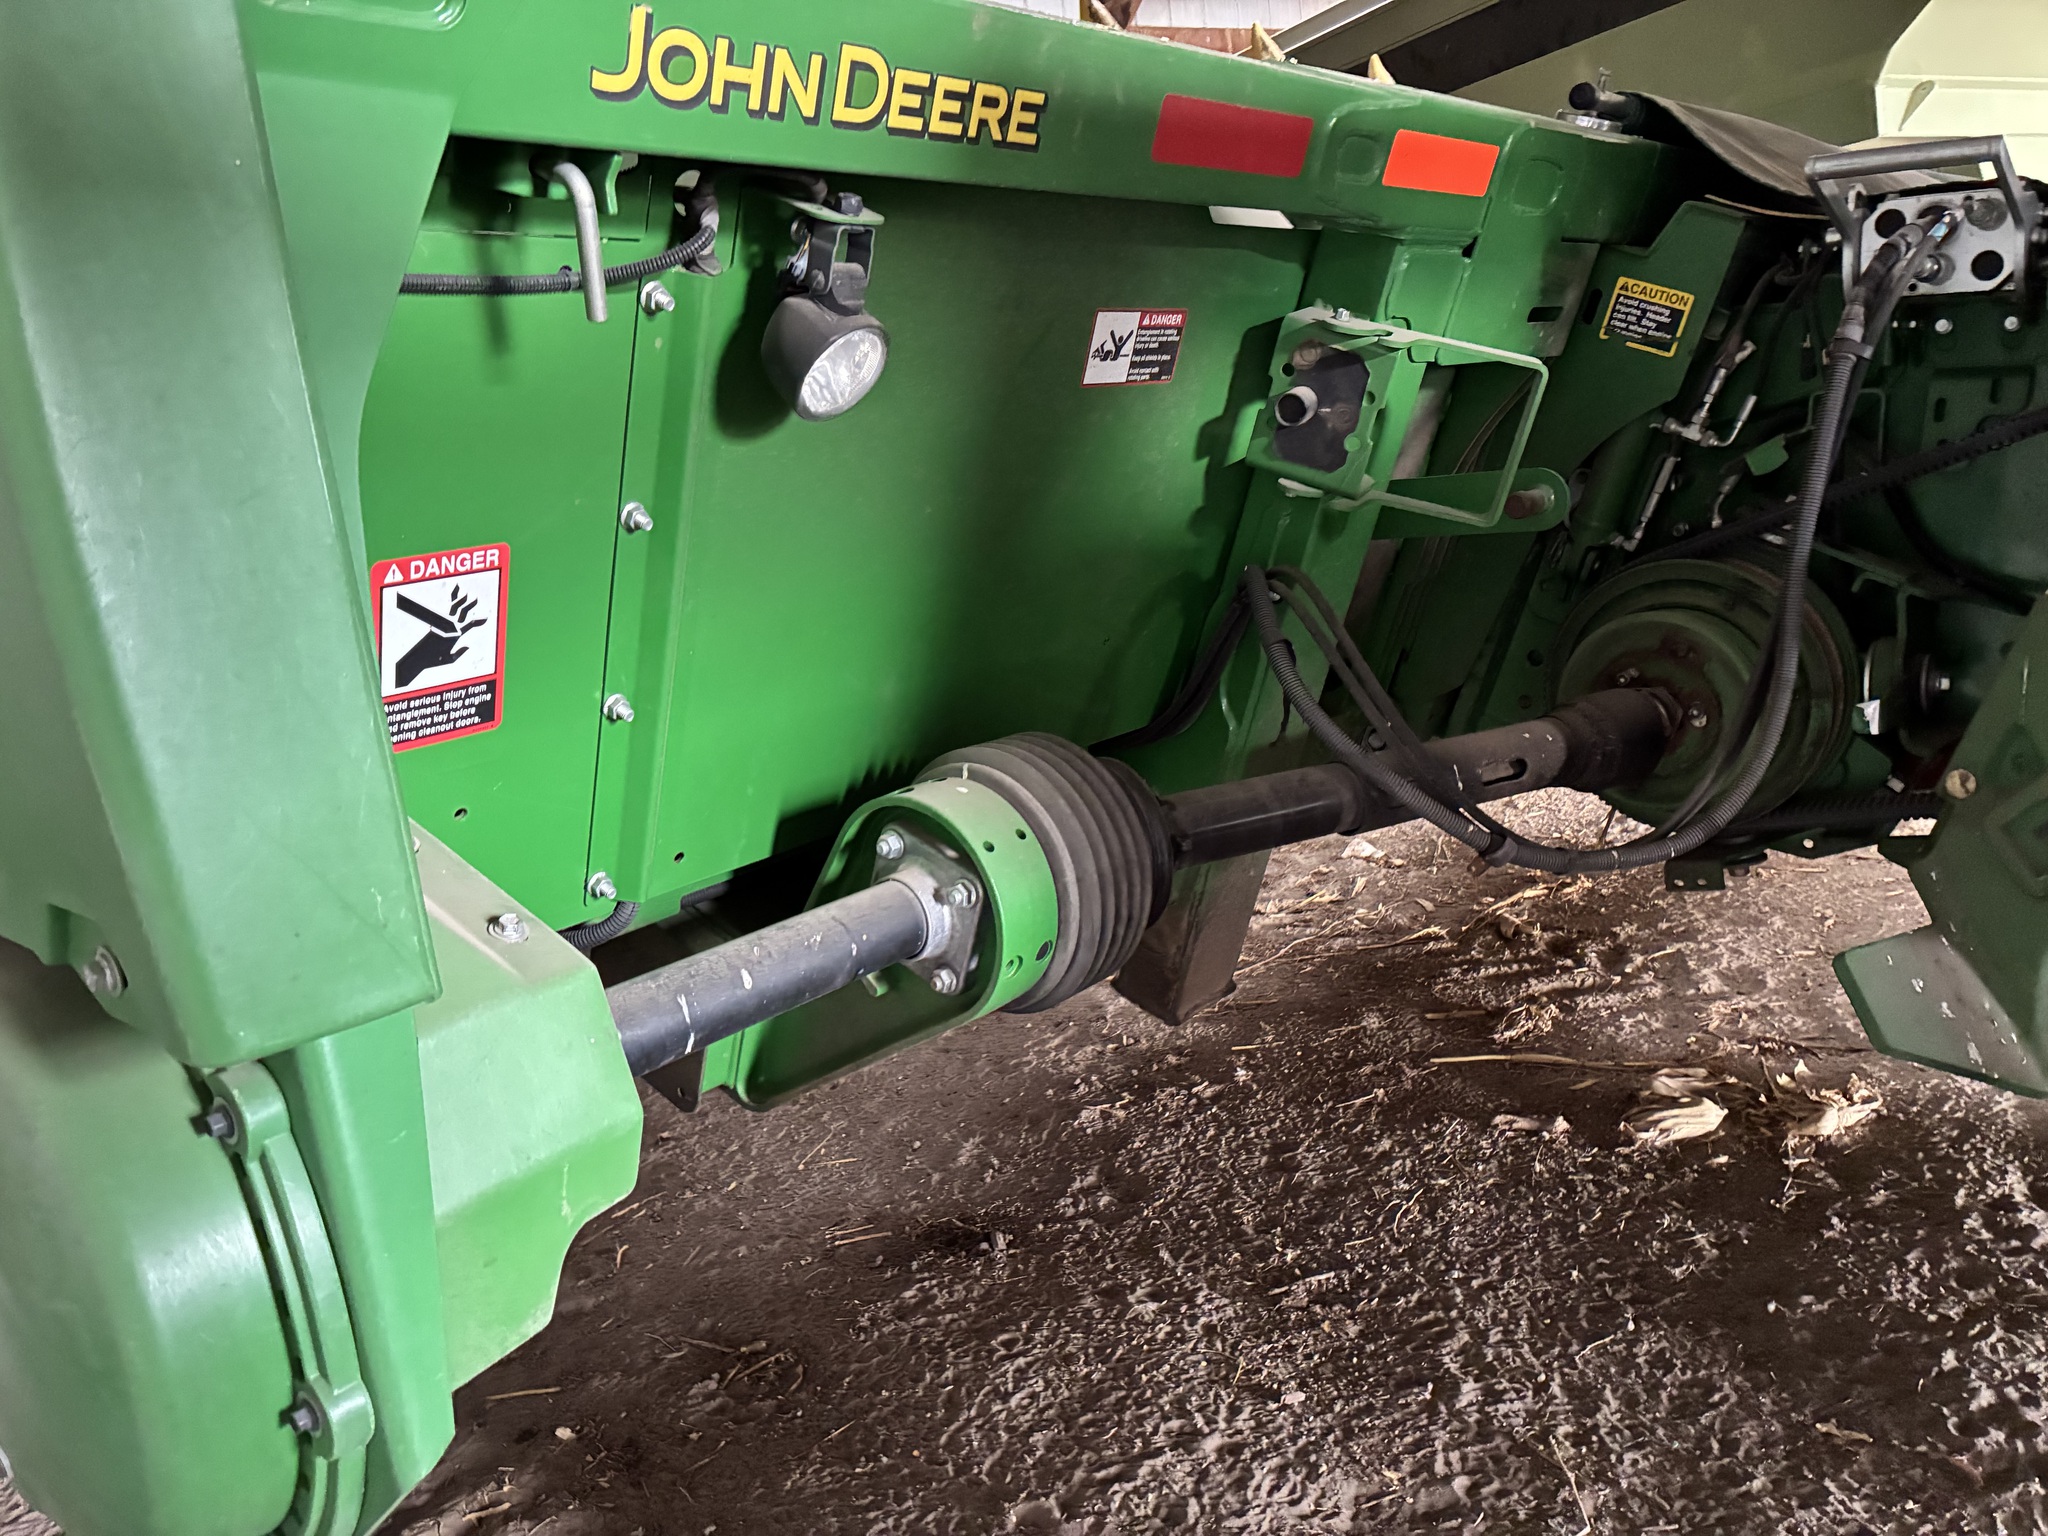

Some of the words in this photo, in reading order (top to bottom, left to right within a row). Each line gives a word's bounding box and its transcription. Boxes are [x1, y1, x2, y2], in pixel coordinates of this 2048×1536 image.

[590, 4, 827, 125] JOHN
[831, 41, 1048, 152] DEERE
[1618, 296, 1639, 306] Avoid
[1639, 302, 1671, 317] crushing
[1630, 284, 1690, 307] CAUTION
[1150, 313, 1182, 326] DANGER
[1610, 319, 1628, 328] clear
[1628, 325, 1648, 334] when
[1640, 318, 1657, 329] Stay
[1646, 312, 1672, 323] Header
[410, 548, 500, 580] DANGER
[384, 700, 408, 713] Avoid
[410, 694, 441, 708] serious
[443, 688, 466, 701] injury
[468, 684, 487, 694] from
[387, 704, 442, 724] ntanglement.
[444, 700, 463, 711] Stop
[465, 693, 492, 706] engine
[389, 724, 398, 734] nd
[400, 718, 431, 730] remove
[434, 712, 448, 723] key
[450, 707, 476, 719] before
[390, 730, 416, 743] ening
[418, 721, 454, 737] cleanout
